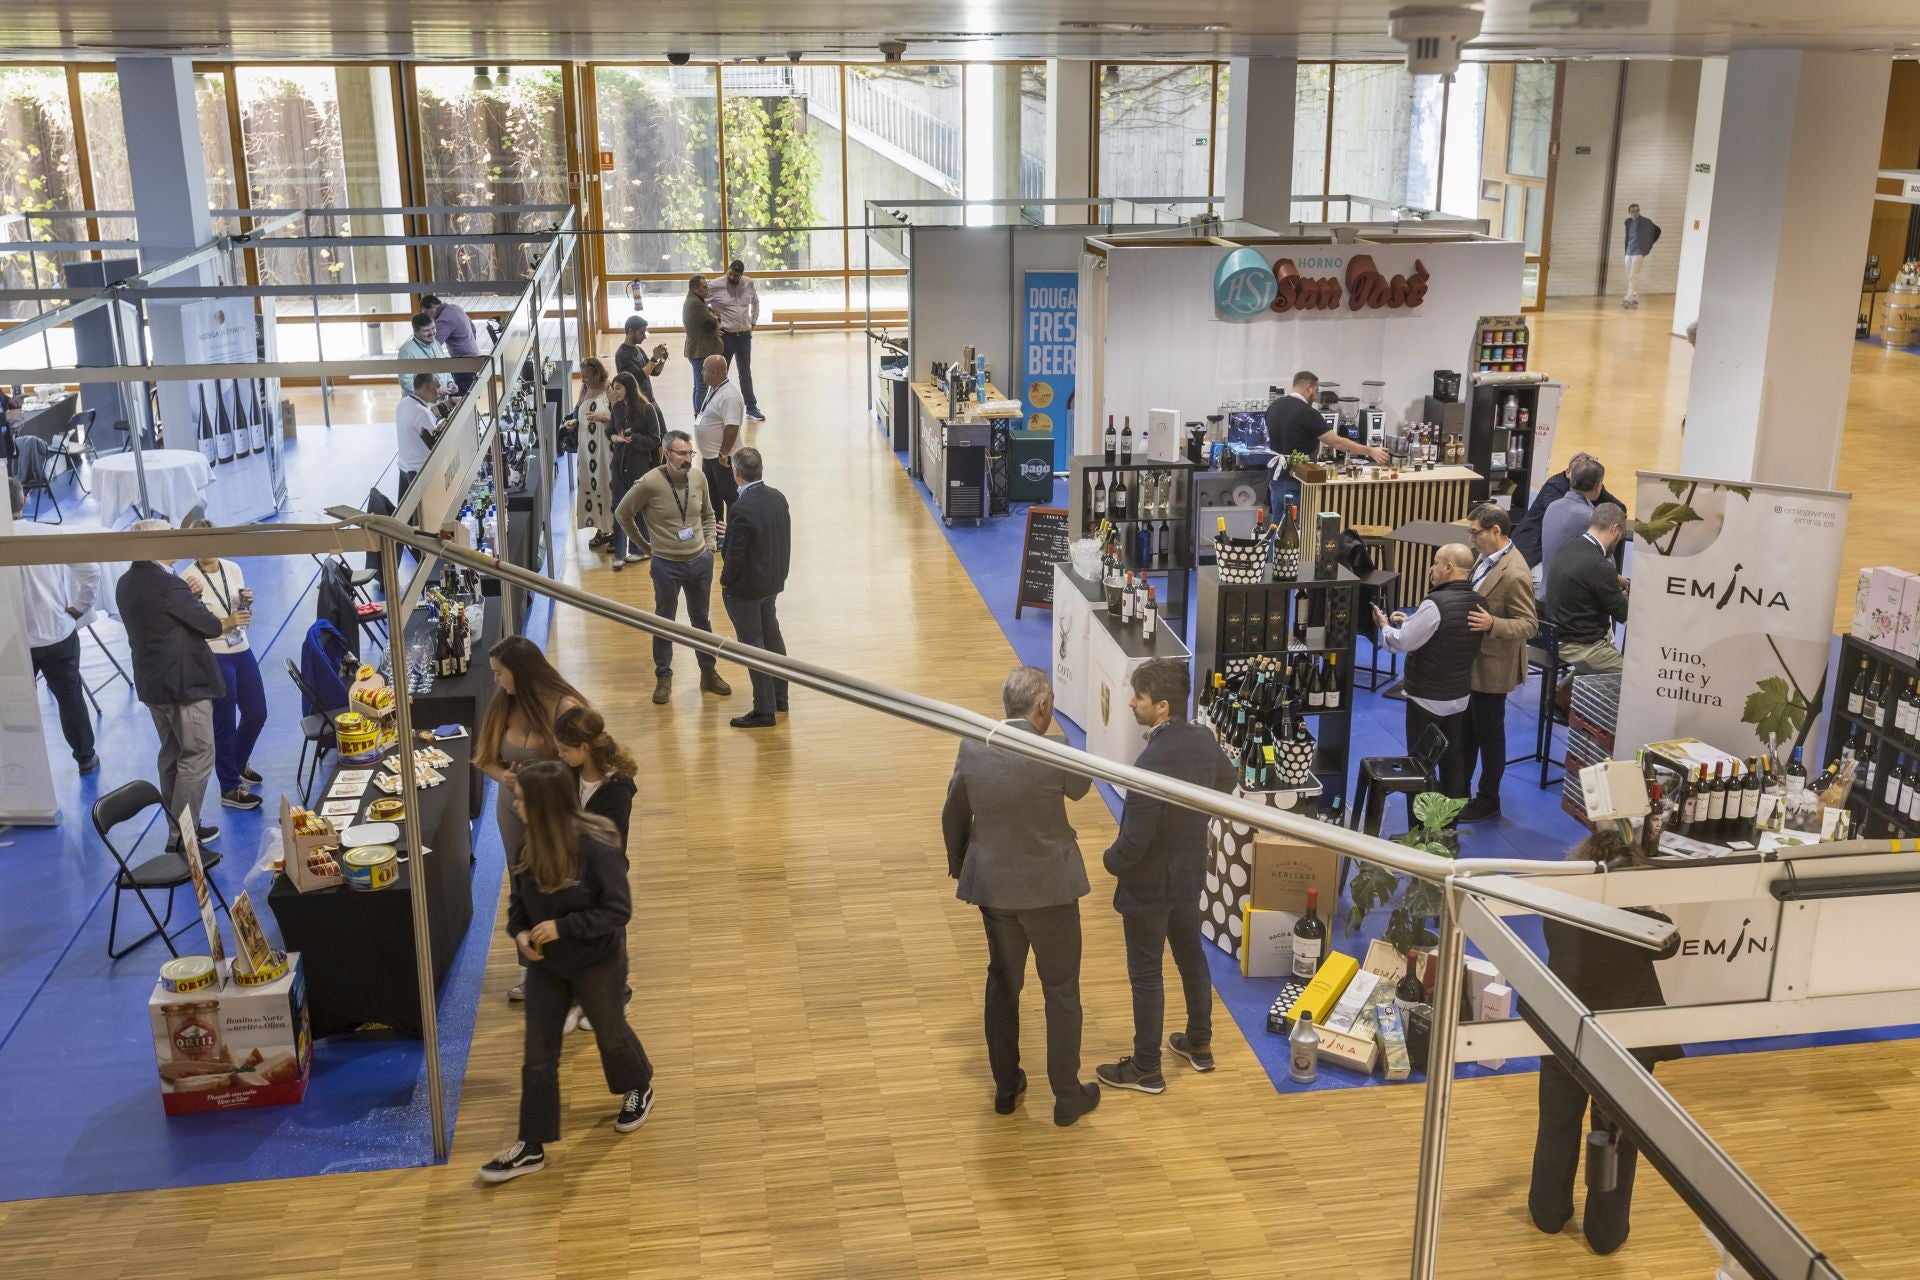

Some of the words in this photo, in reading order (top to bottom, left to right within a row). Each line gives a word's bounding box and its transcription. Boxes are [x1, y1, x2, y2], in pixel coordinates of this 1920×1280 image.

[1298, 257, 1343, 269] HORNO
[1270, 258, 1343, 313] San
[1345, 254, 1430, 312] José
[1029, 287, 1078, 309] DOUGA
[1029, 312, 1076, 342] FRES
[1028, 344, 1076, 376] BEER
[1020, 463, 1050, 476] pago
[1794, 516, 1835, 528] emina.es
[1661, 646, 1706, 668] Vino,
[1657, 667, 1695, 683] arte
[1700, 674, 1711, 688] y
[1656, 686, 1722, 707] cultura
[1681, 918, 1775, 962] EMIN
[237, 973, 272, 985] ORTIZ
[176, 1035, 214, 1048] ORTIZ
[1319, 1034, 1357, 1056] MINA
